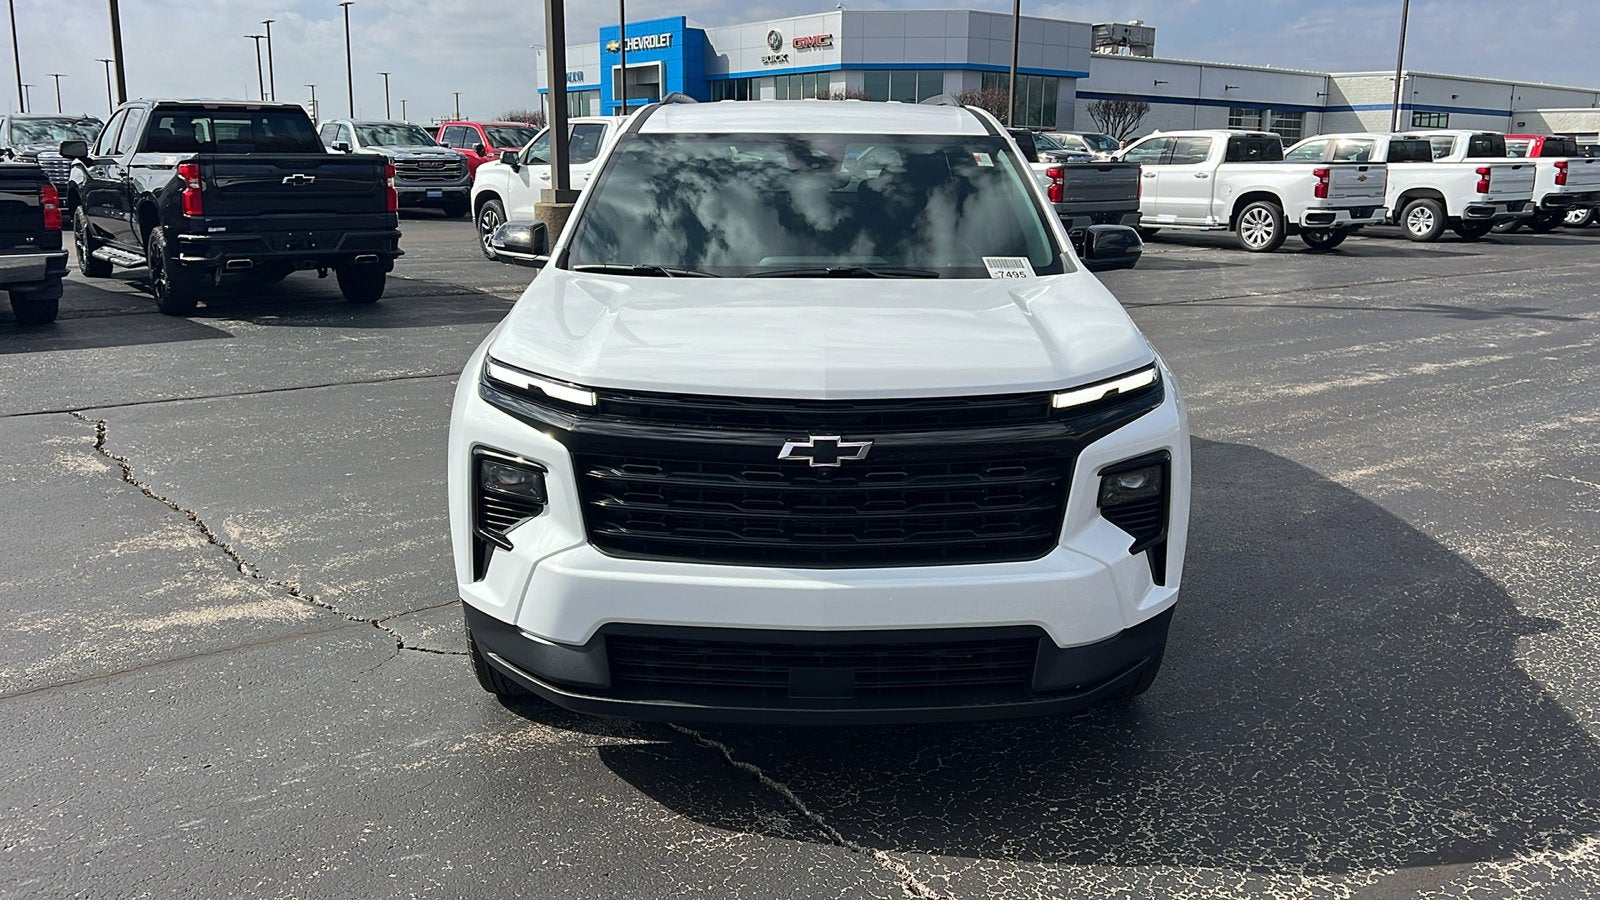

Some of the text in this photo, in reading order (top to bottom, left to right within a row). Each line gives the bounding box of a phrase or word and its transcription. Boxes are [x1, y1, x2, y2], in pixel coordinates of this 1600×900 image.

[623, 32, 672, 51] CHEVROLET
[792, 33, 834, 49] GMC
[761, 54, 789, 64] BUICK
